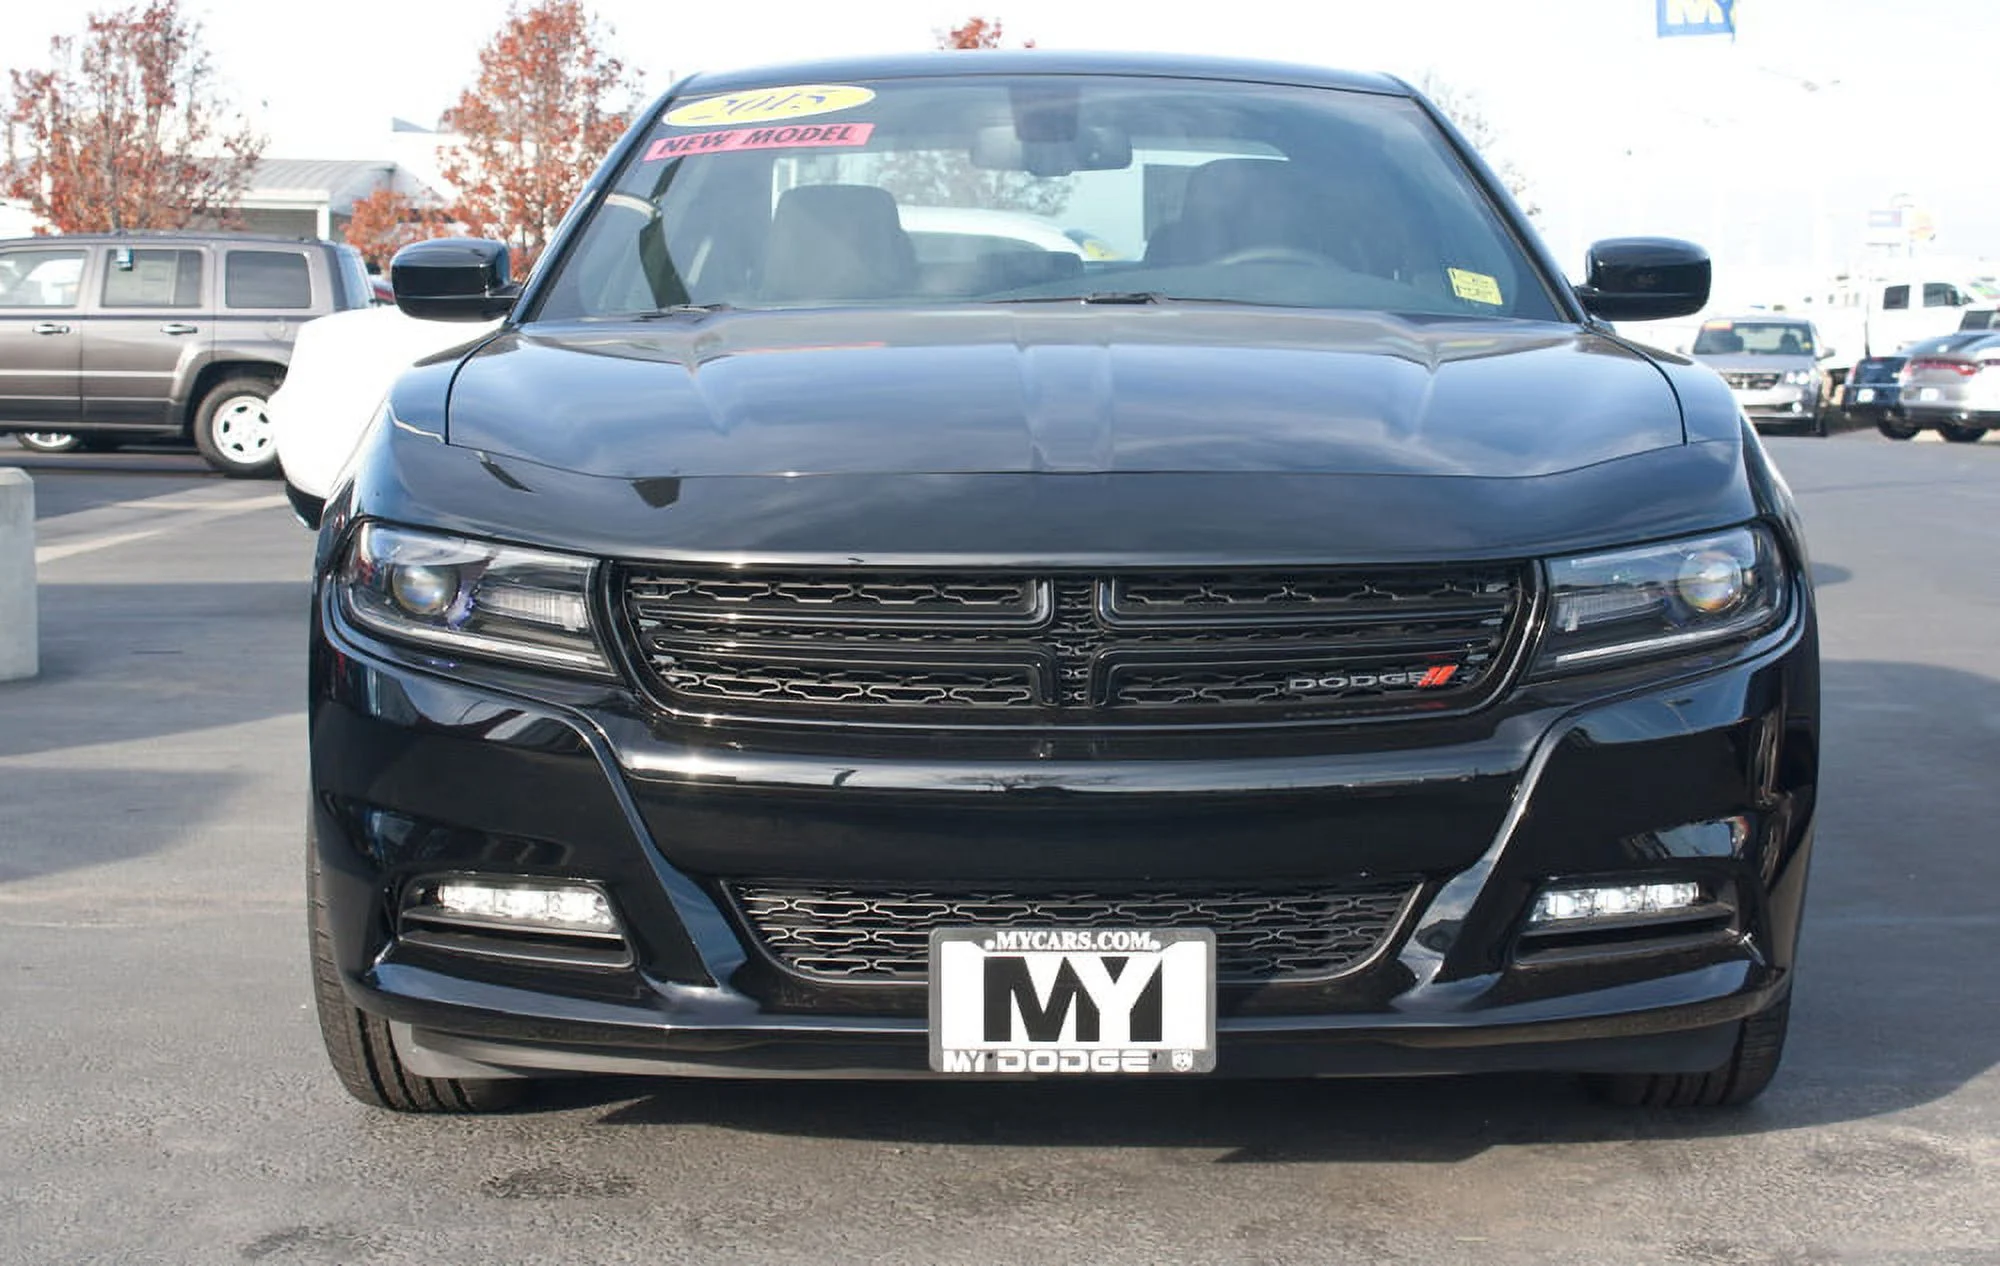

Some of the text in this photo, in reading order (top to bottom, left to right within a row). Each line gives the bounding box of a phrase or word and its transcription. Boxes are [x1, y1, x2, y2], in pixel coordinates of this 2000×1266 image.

[658, 126, 852, 154] NEW MODEL
[1289, 671, 1431, 690] DODGE
[983, 956, 1163, 1042] MY
[943, 1050, 1150, 1073] MY DODGE
